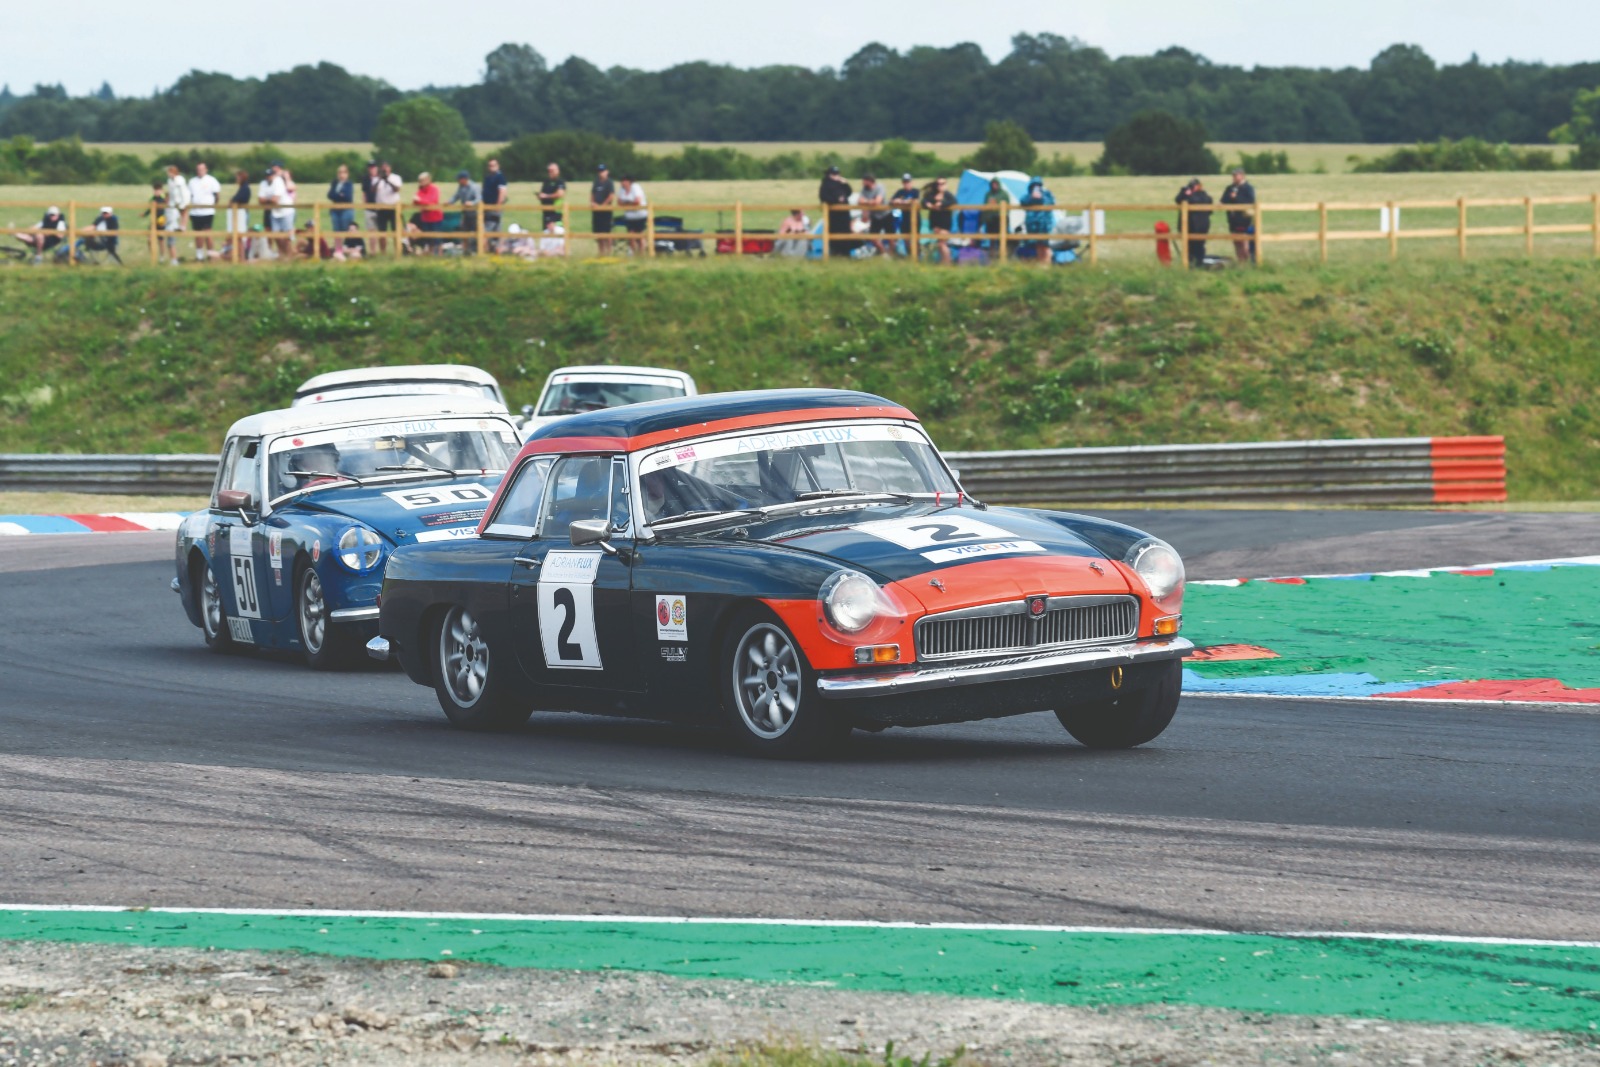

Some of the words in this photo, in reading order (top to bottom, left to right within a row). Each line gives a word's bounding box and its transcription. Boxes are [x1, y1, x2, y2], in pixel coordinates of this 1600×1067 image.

[403, 489, 487, 506] 50
[907, 523, 982, 542] 2
[948, 543, 1019, 555] VISION
[233, 557, 257, 612] 50
[553, 587, 584, 661] 2
